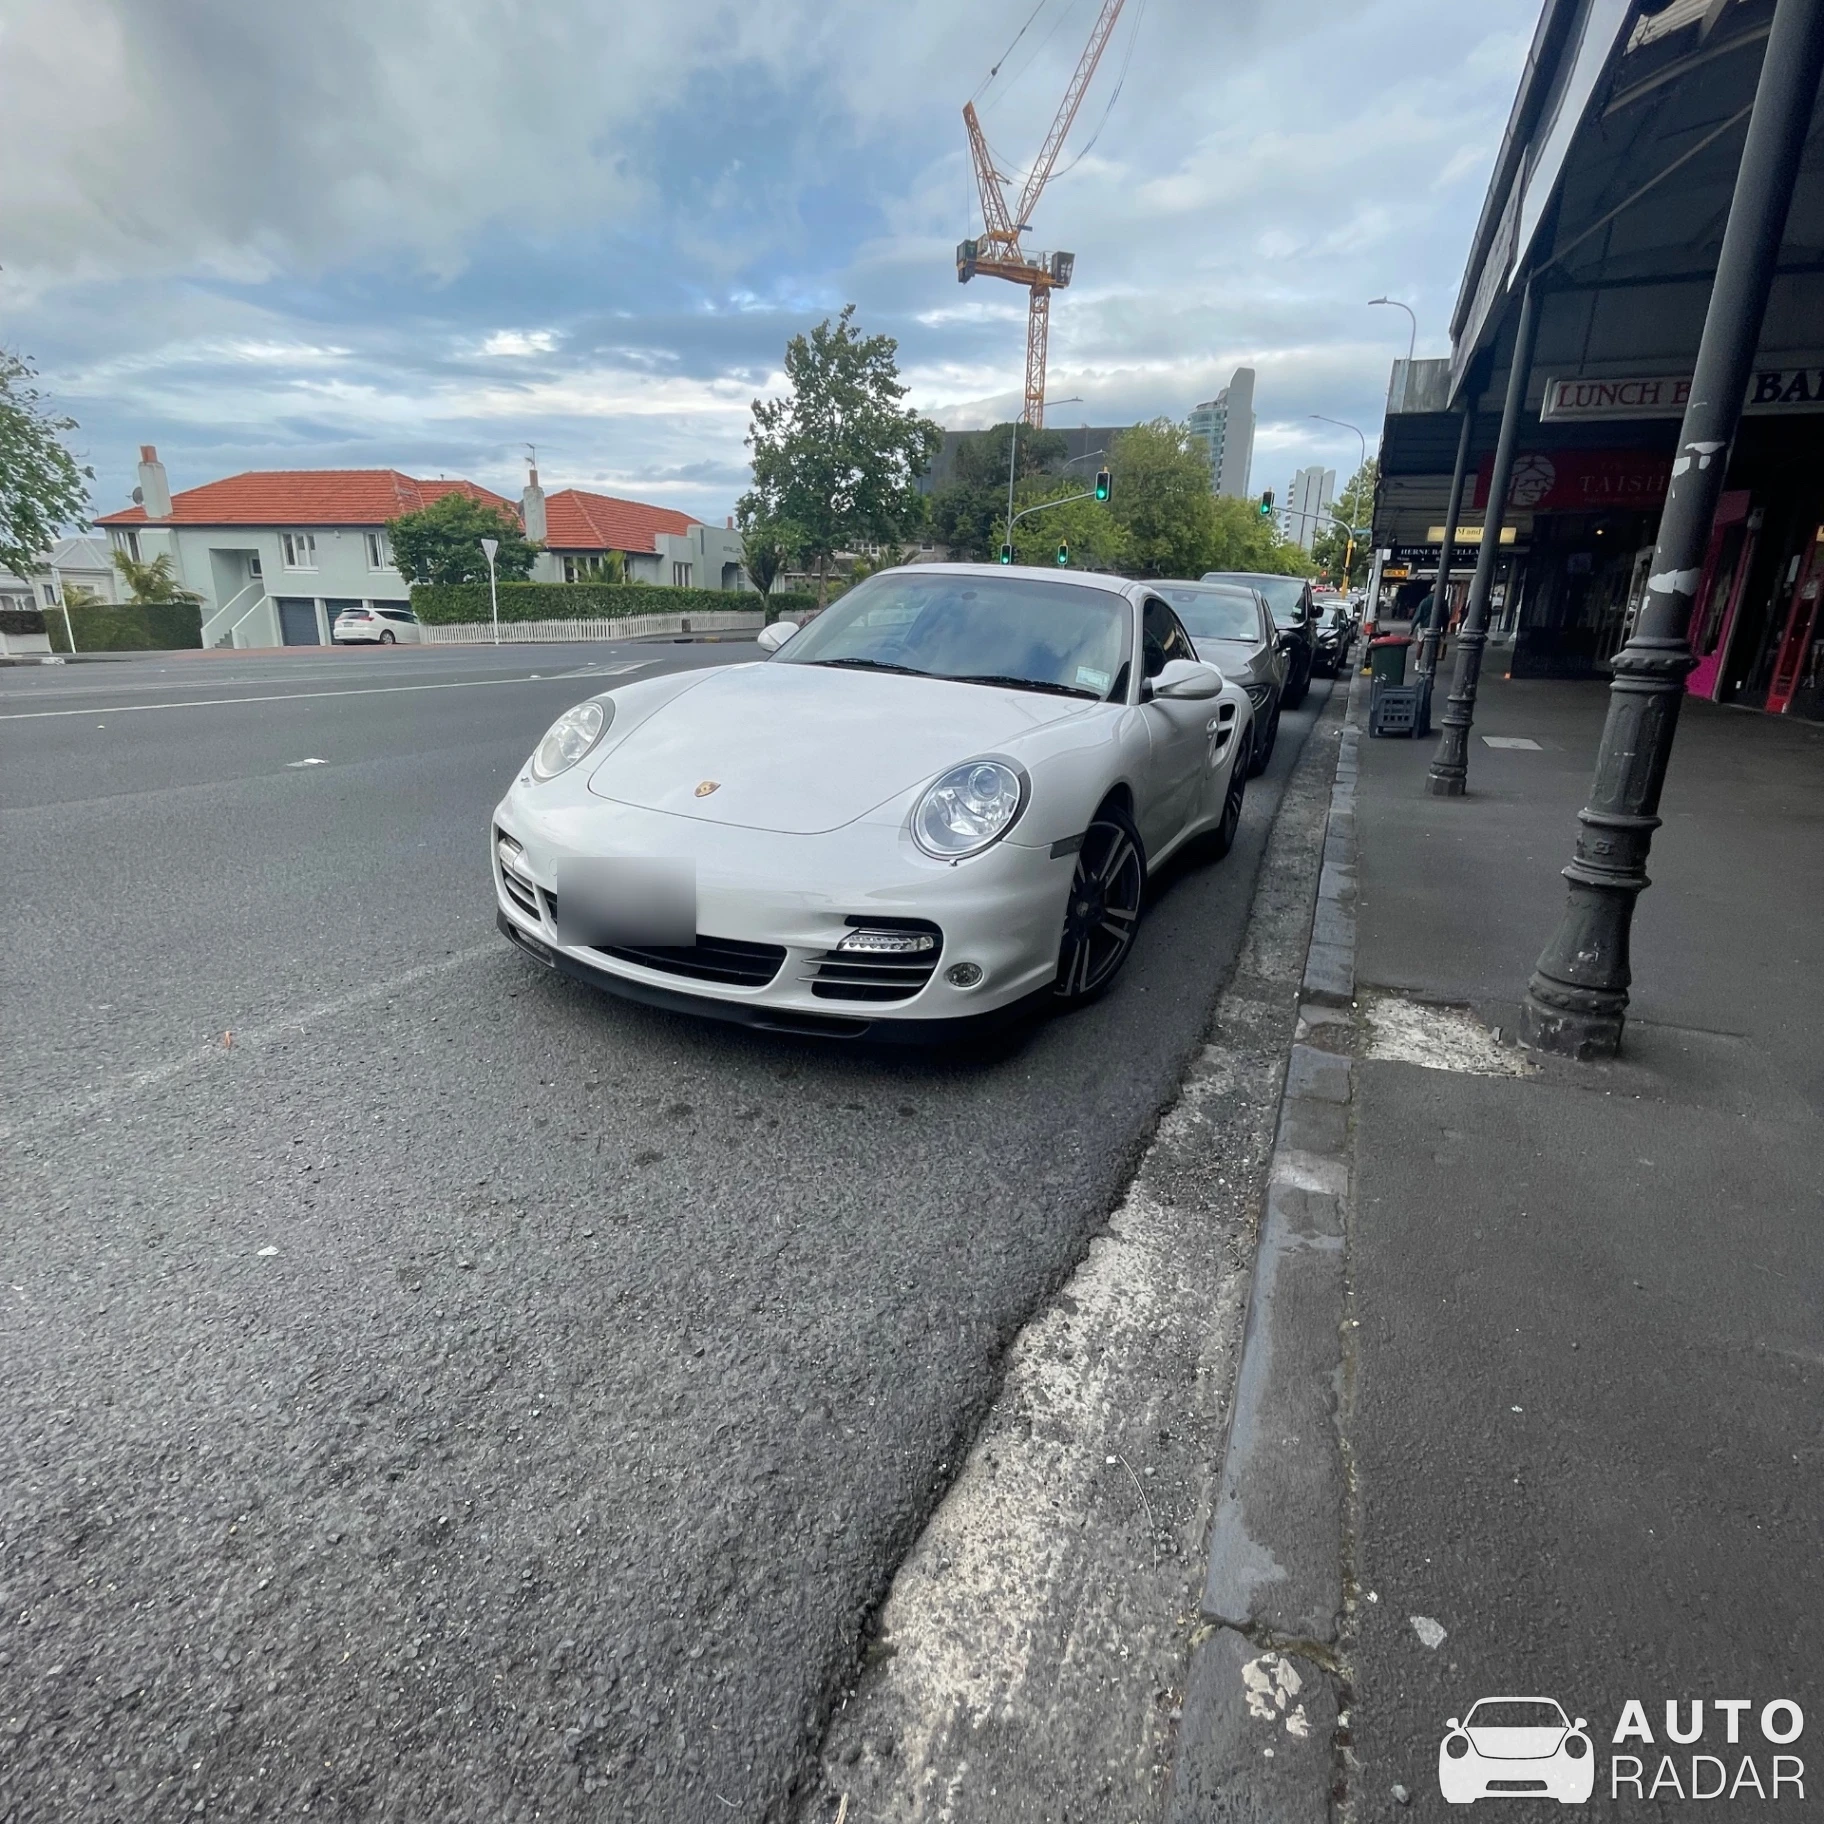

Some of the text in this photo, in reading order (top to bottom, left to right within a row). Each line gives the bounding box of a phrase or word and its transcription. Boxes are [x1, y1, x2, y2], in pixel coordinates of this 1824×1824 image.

[1557, 381, 1663, 408] LUNCH
[1580, 475, 1665, 492] TAISH
[1400, 548, 1430, 556] HERNE
[1451, 548, 1481, 556] CELLA
